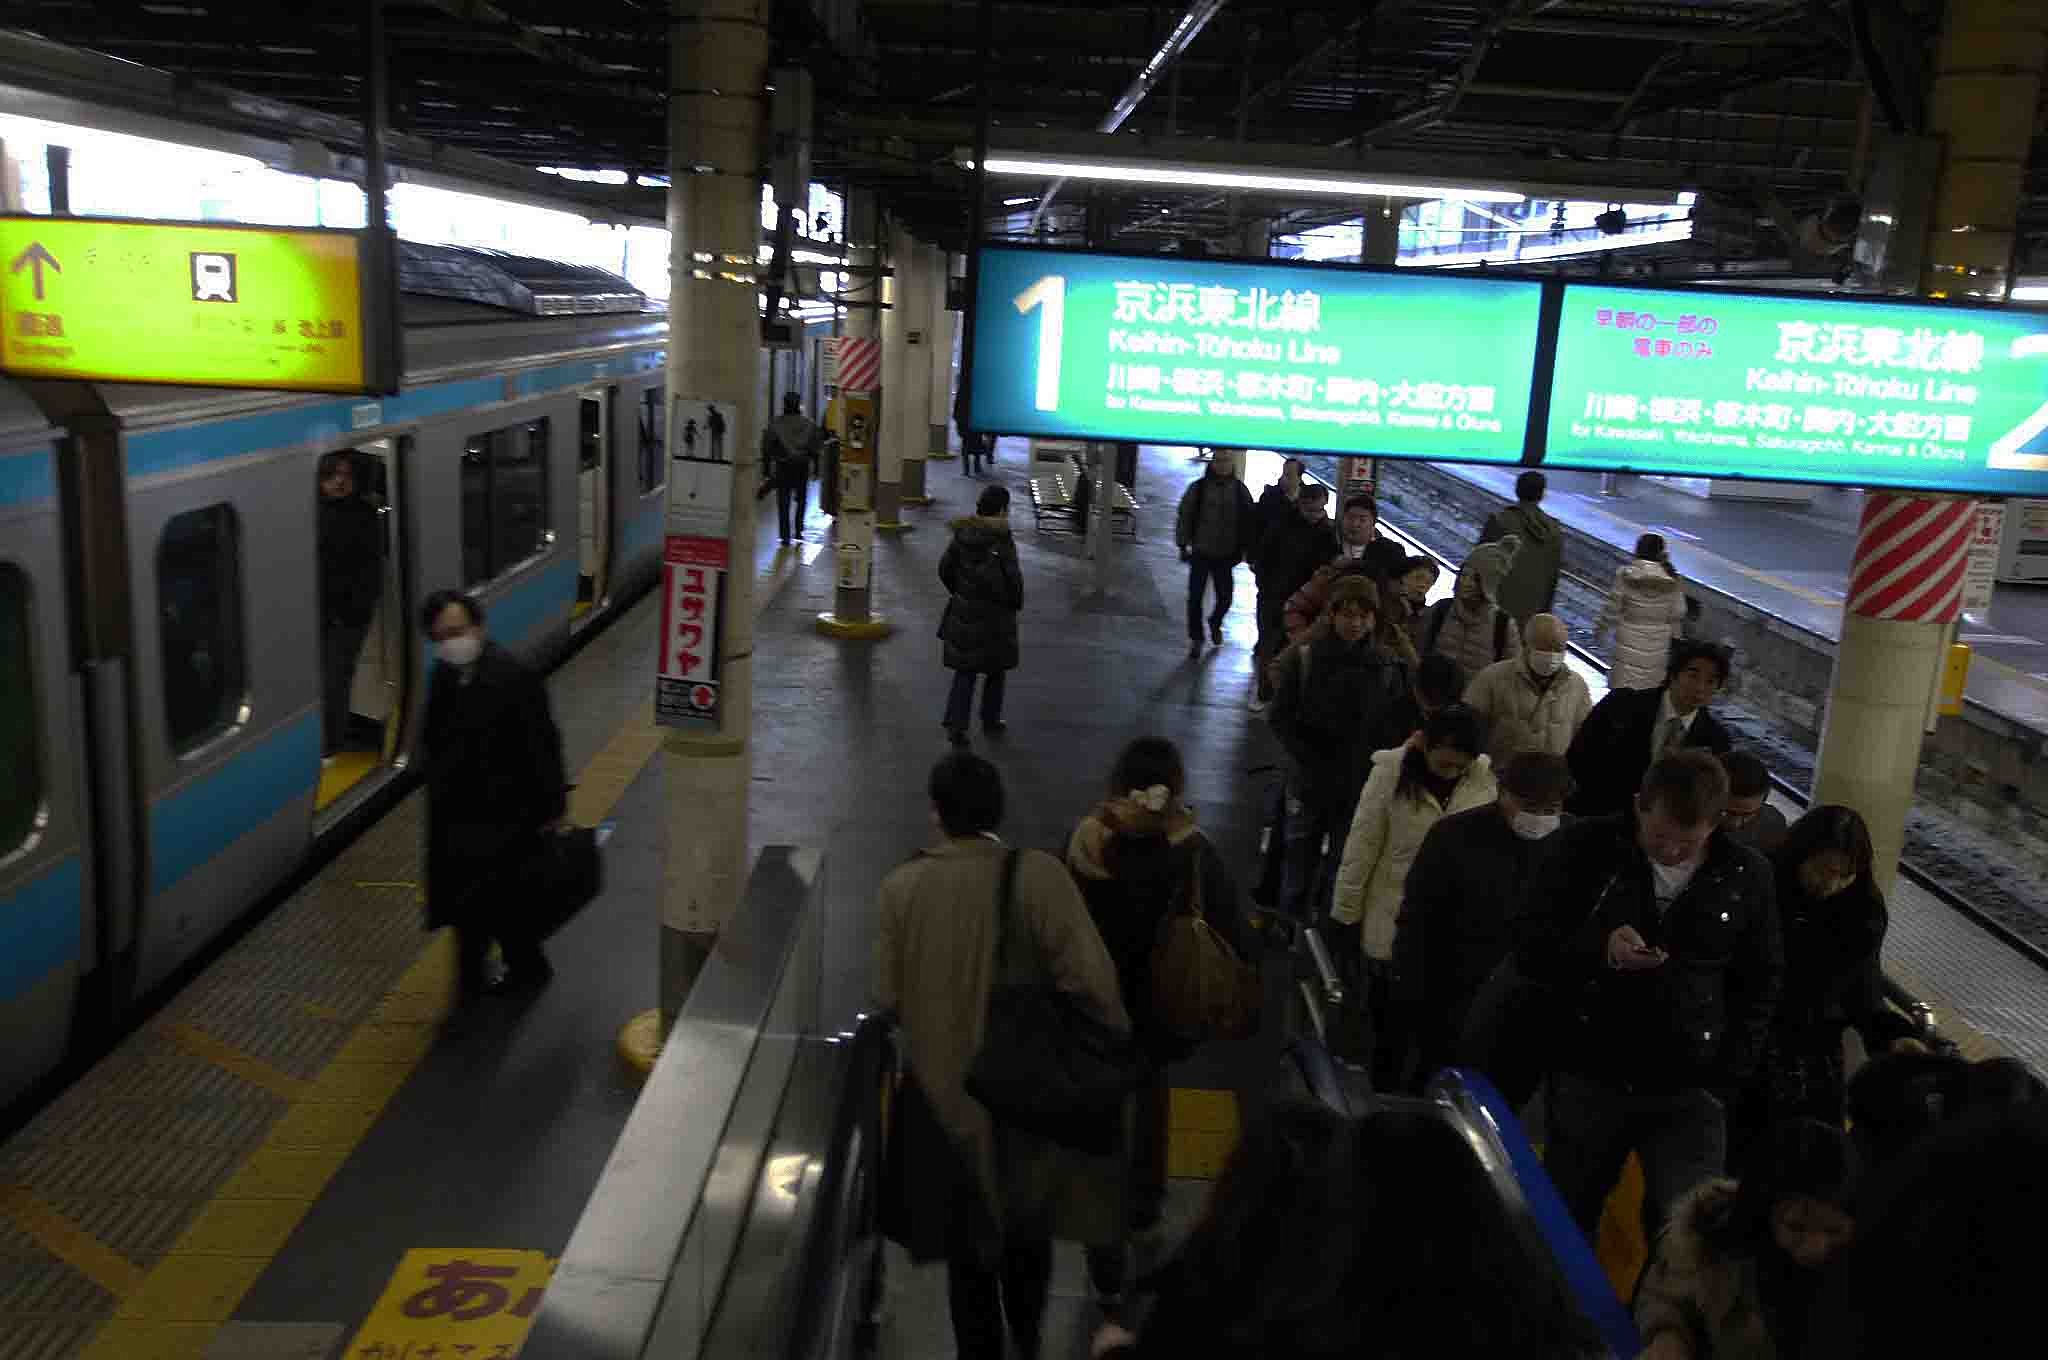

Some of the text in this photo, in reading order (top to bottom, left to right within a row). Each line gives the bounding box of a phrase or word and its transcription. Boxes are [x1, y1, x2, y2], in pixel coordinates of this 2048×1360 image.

[1112, 279, 1321, 332] 京浜東北線
[1013, 275, 1065, 411] 1
[1287, 337, 1342, 365] Line
[1775, 321, 1985, 373] 京浜東北線
[1925, 378, 1978, 405] Line
[1986, 333, 2048, 472] 2
